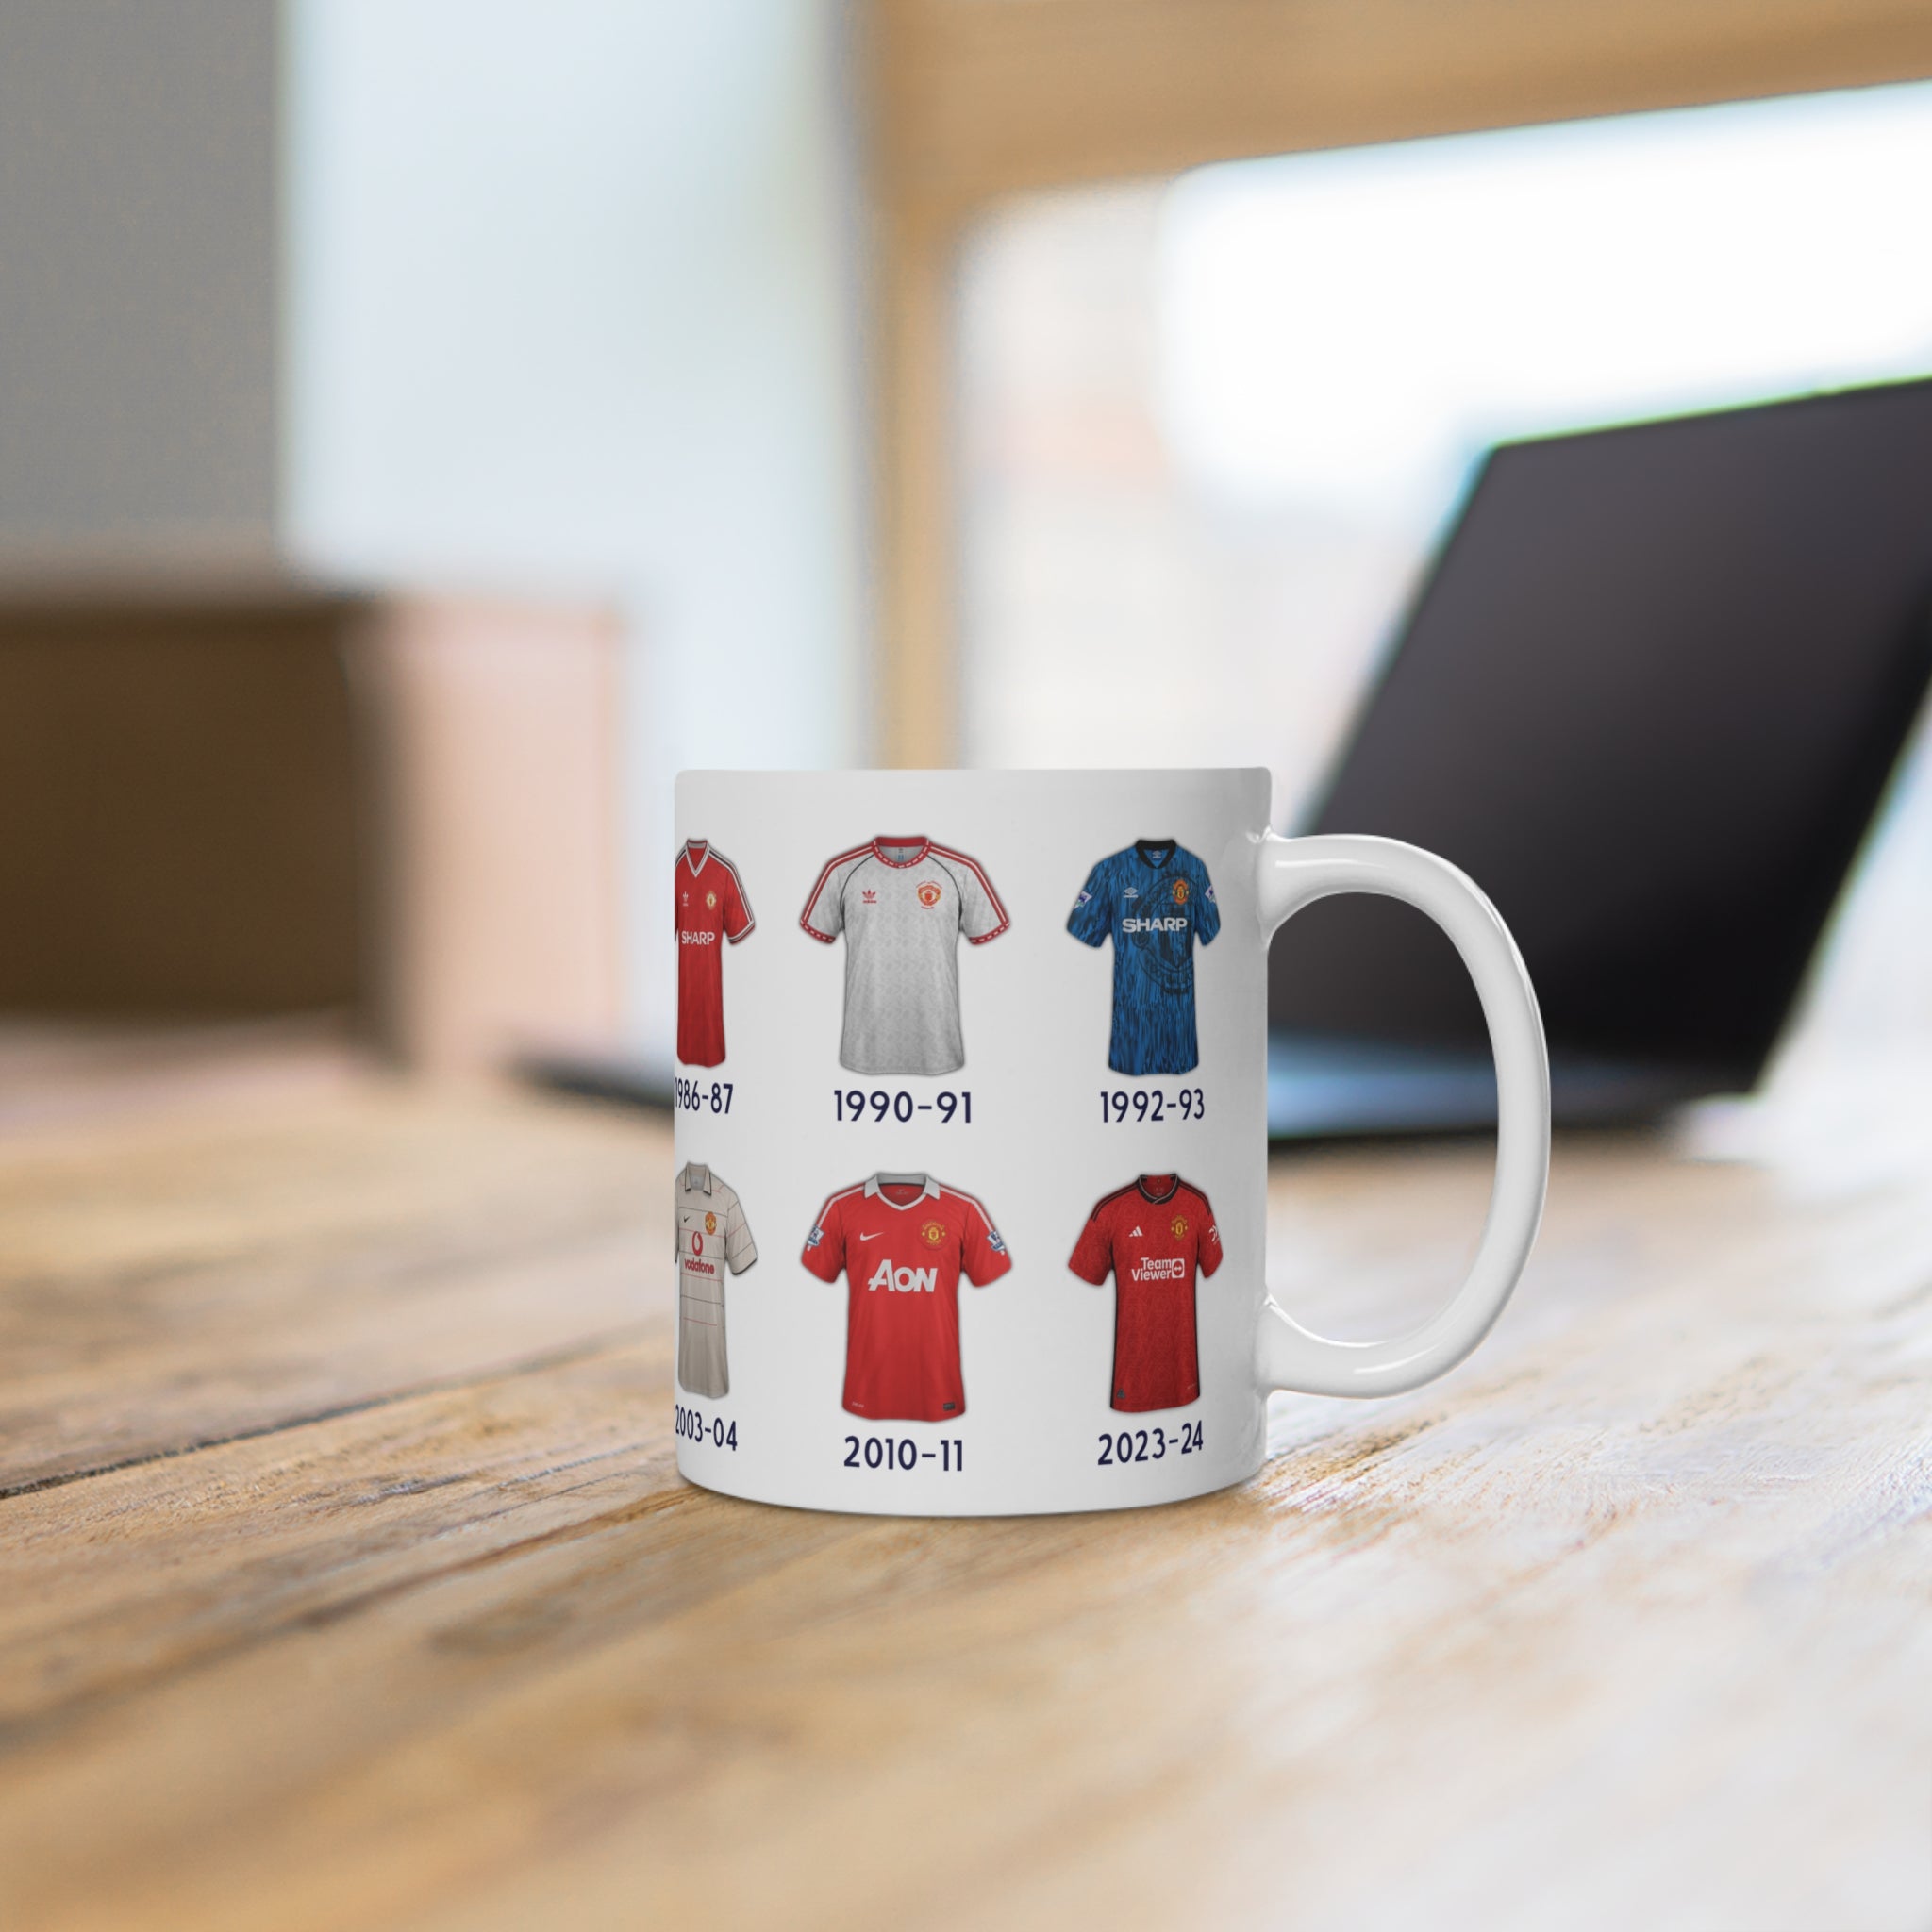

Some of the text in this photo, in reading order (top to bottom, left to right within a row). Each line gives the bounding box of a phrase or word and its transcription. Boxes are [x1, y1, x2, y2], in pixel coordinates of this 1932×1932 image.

[681, 930, 715, 945] SHARP
[1122, 917, 1188, 933] SHARP
[675, 1076, 733, 1114] 1986-87
[834, 1090, 971, 1124] 1990-91
[1100, 1088, 1205, 1123] 1992-93
[684, 1257, 715, 1274] vodafone
[1131, 1267, 1172, 1281] Viewer
[1140, 1257, 1172, 1270] Team
[675, 1404, 738, 1451] 2003-04
[1097, 1419, 1204, 1465] 2023-24
[843, 1435, 962, 1472] 2010-11
